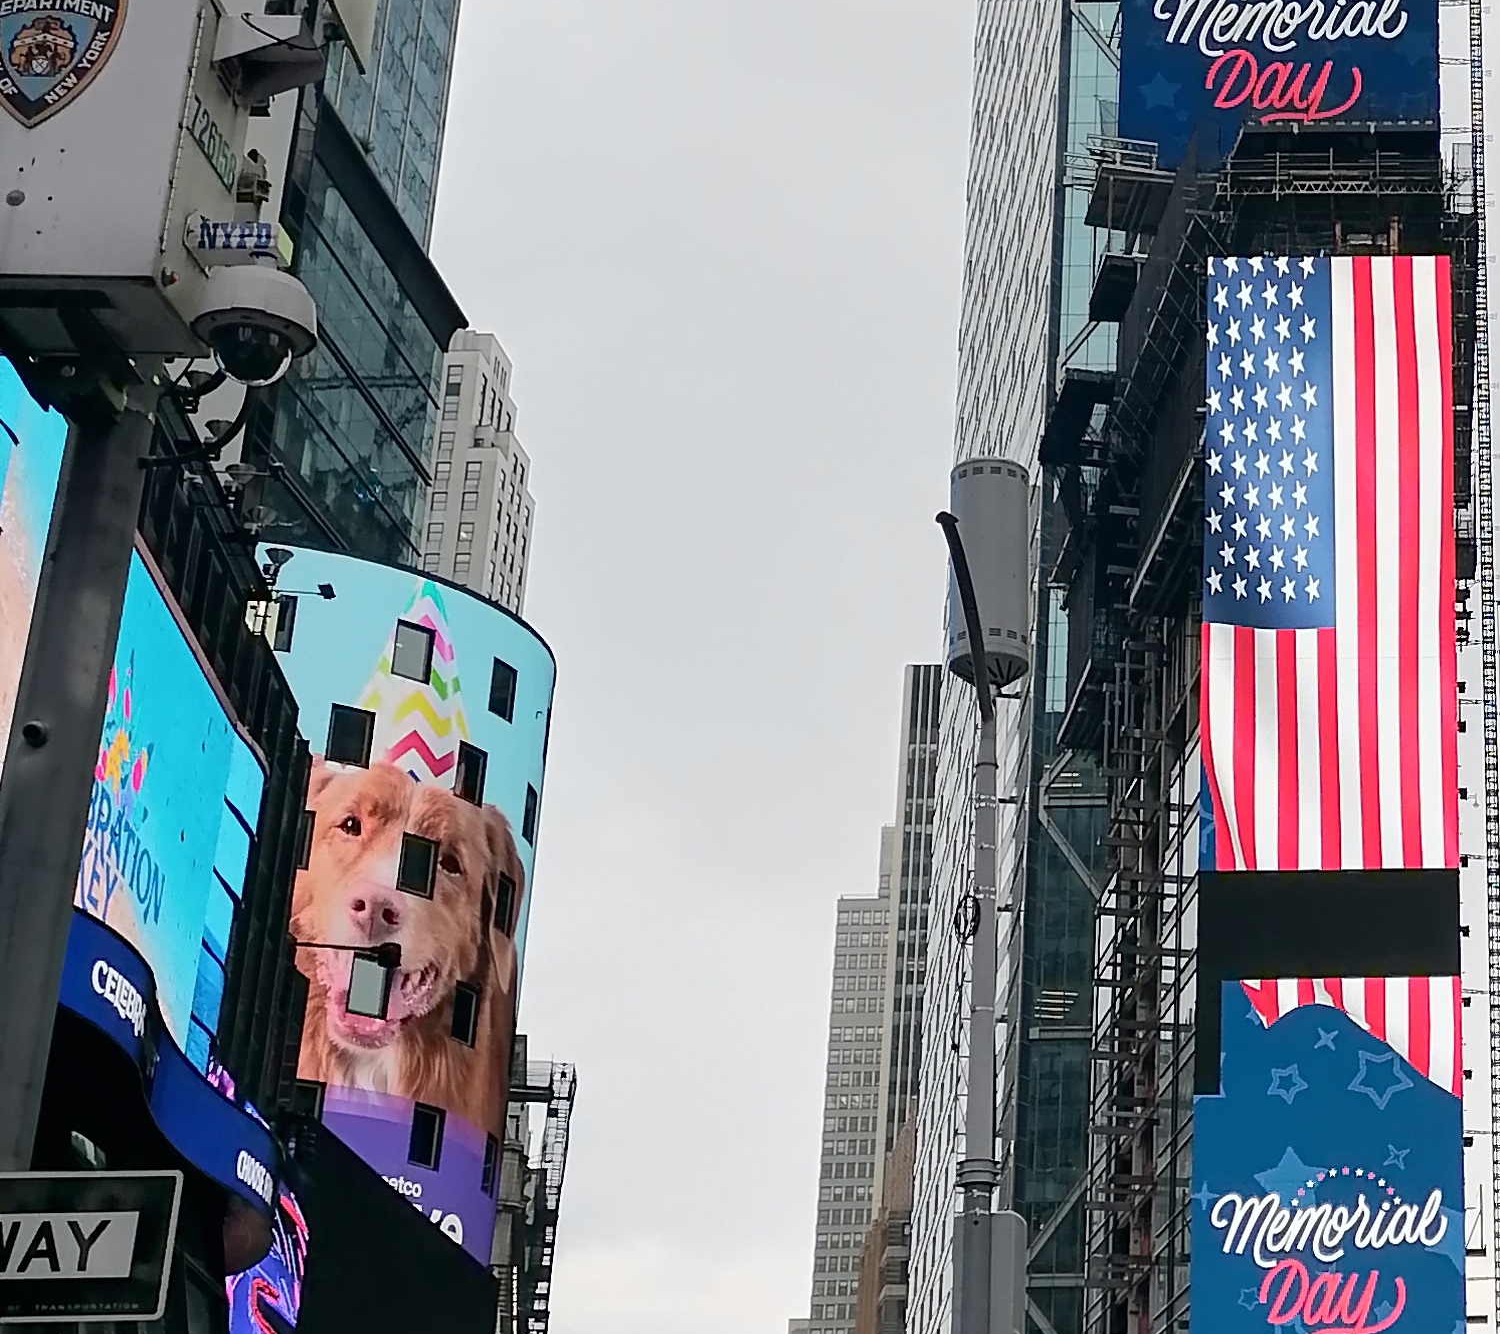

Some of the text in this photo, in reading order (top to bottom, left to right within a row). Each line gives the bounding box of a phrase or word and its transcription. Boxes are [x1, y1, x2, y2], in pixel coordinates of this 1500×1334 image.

[43, 73, 78, 105] NEW
[77, 30, 110, 71] YORK
[1205, 49, 1363, 125] Day
[198, 222, 274, 250] NYPD
[1210, 1188, 1448, 1267] Memorial
